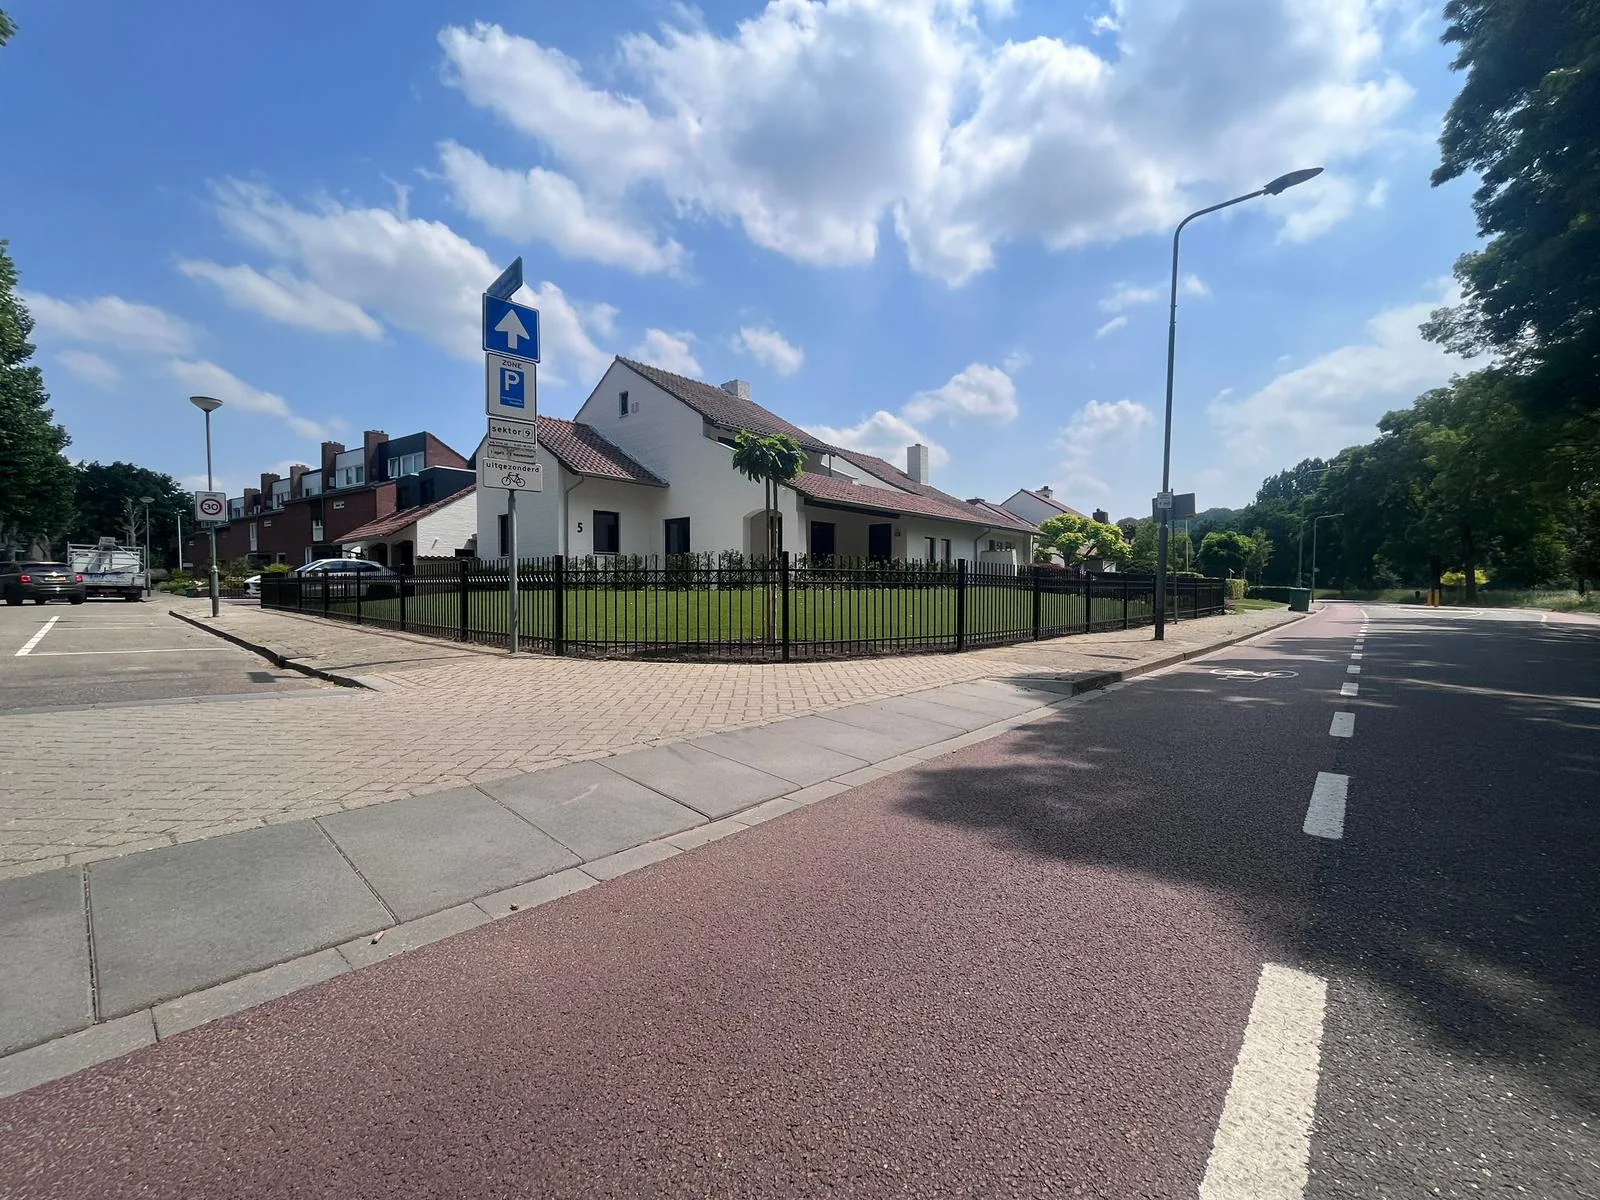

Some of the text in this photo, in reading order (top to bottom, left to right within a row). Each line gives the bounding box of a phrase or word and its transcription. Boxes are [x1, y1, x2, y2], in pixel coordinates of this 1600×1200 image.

[502, 359, 522, 369] ZONE
[504, 370, 520, 391] P
[491, 426, 521, 436] sektor
[486, 461, 540, 473] uitgezonderd
[203, 503, 219, 511] 30
[577, 522, 583, 533] 5
